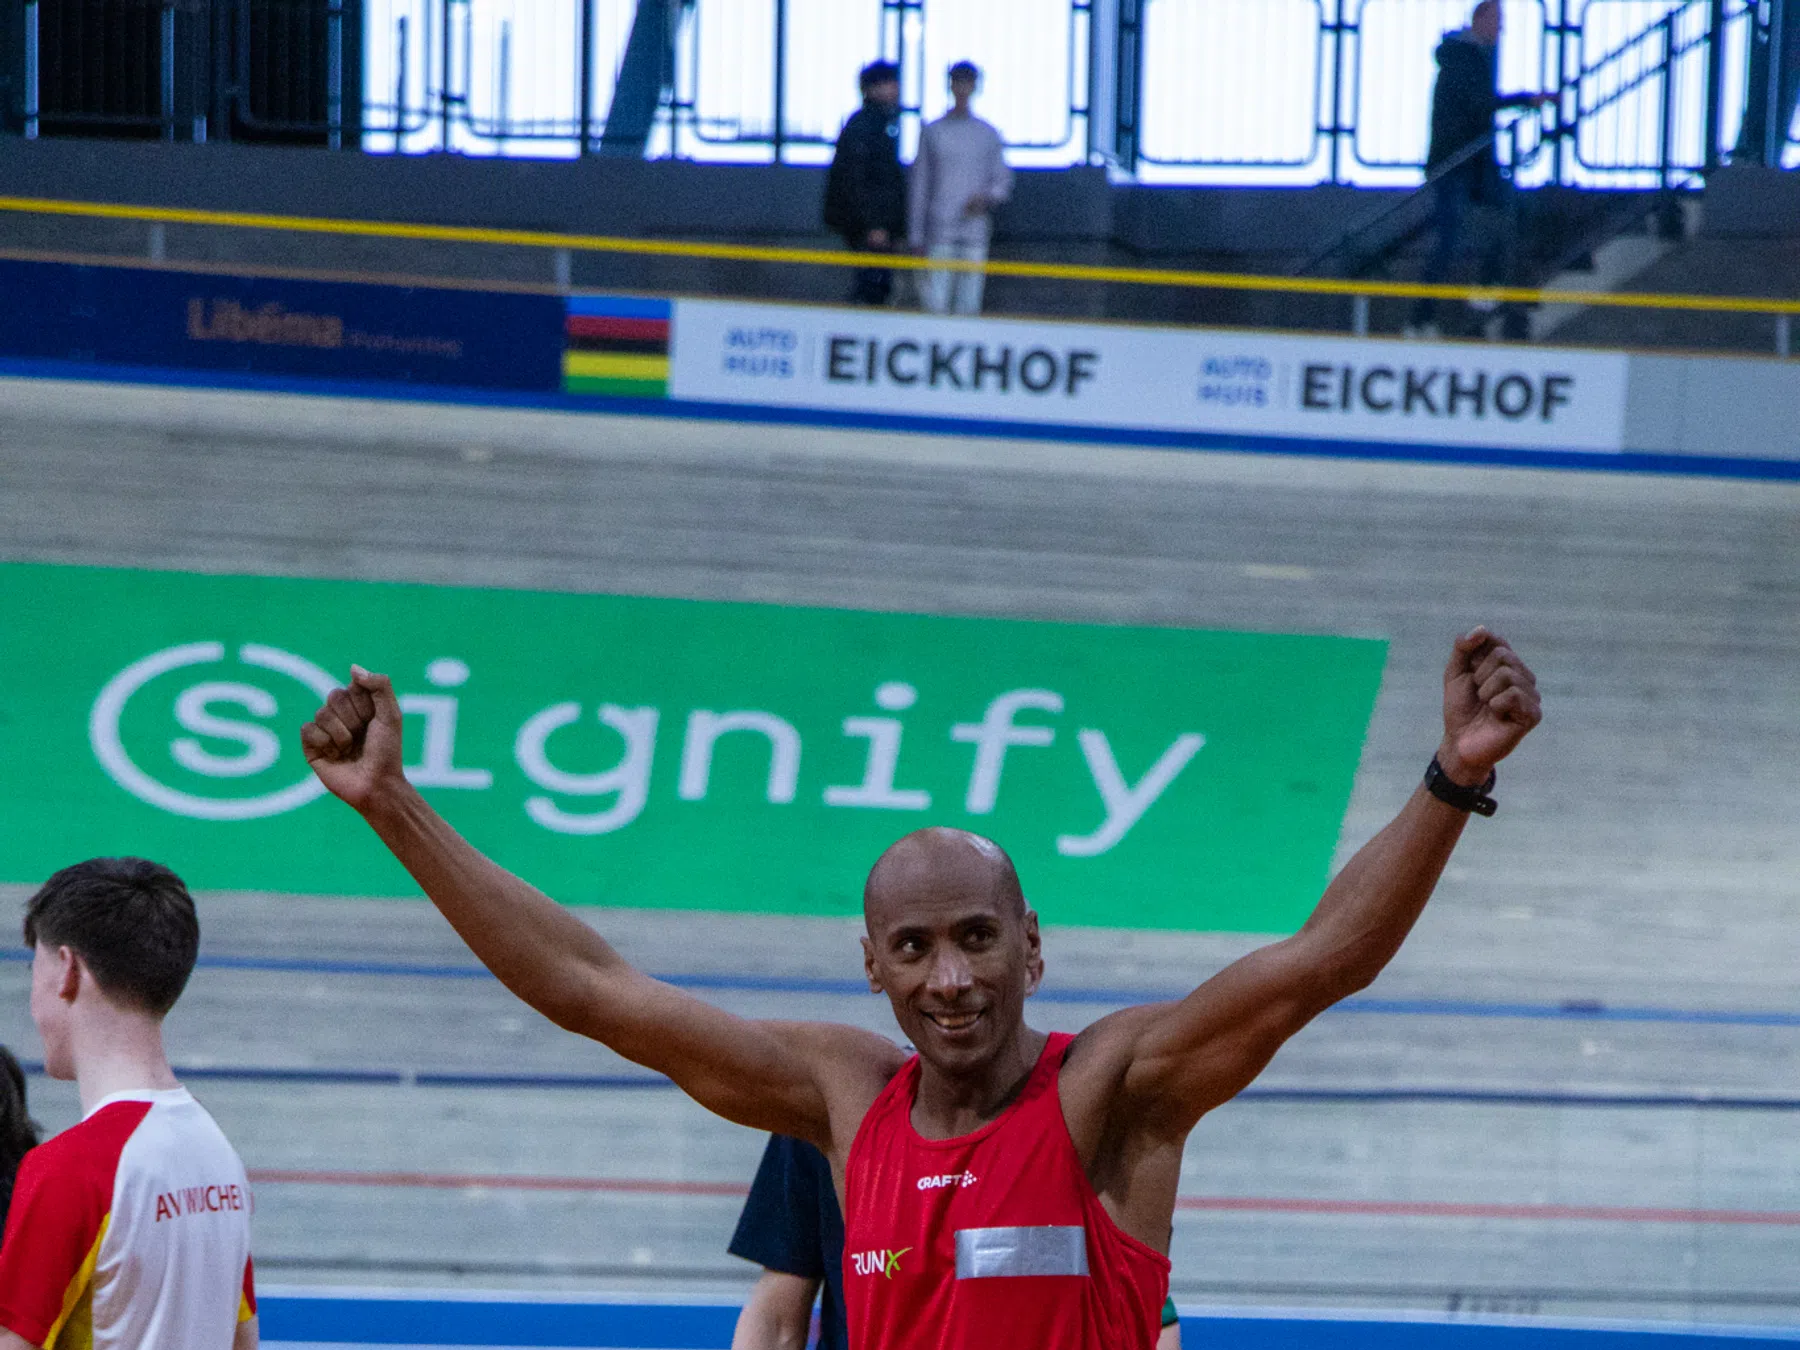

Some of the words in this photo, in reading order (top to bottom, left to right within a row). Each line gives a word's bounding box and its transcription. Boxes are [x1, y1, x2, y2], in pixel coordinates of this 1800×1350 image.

[826, 333, 1100, 397] EICKHOF
[1301, 362, 1575, 423] EICKHOF
[916, 1173, 962, 1191] CRAFT
